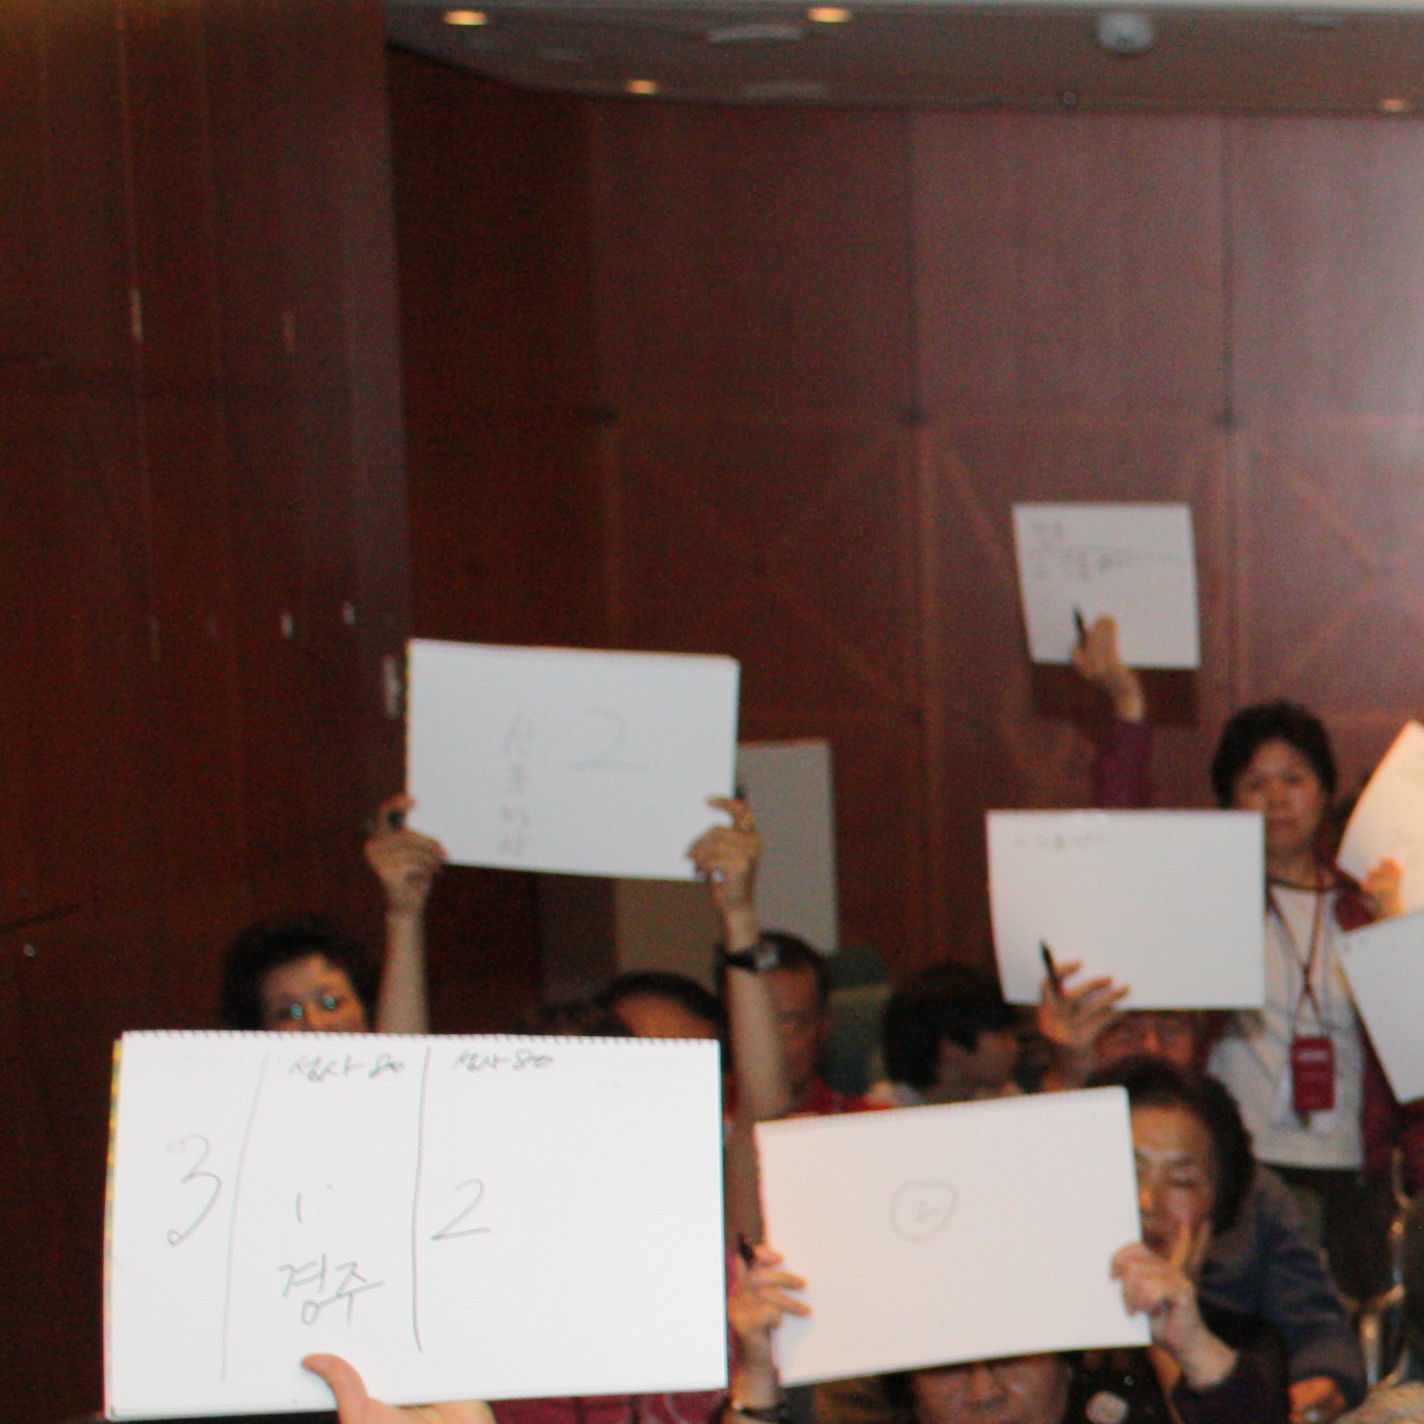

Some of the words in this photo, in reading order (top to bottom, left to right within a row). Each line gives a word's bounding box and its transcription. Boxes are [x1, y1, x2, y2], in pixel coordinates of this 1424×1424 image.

[167, 1135, 224, 1246] 3
[430, 1180, 492, 1242] 2
[279, 1254, 388, 1329] 경주
